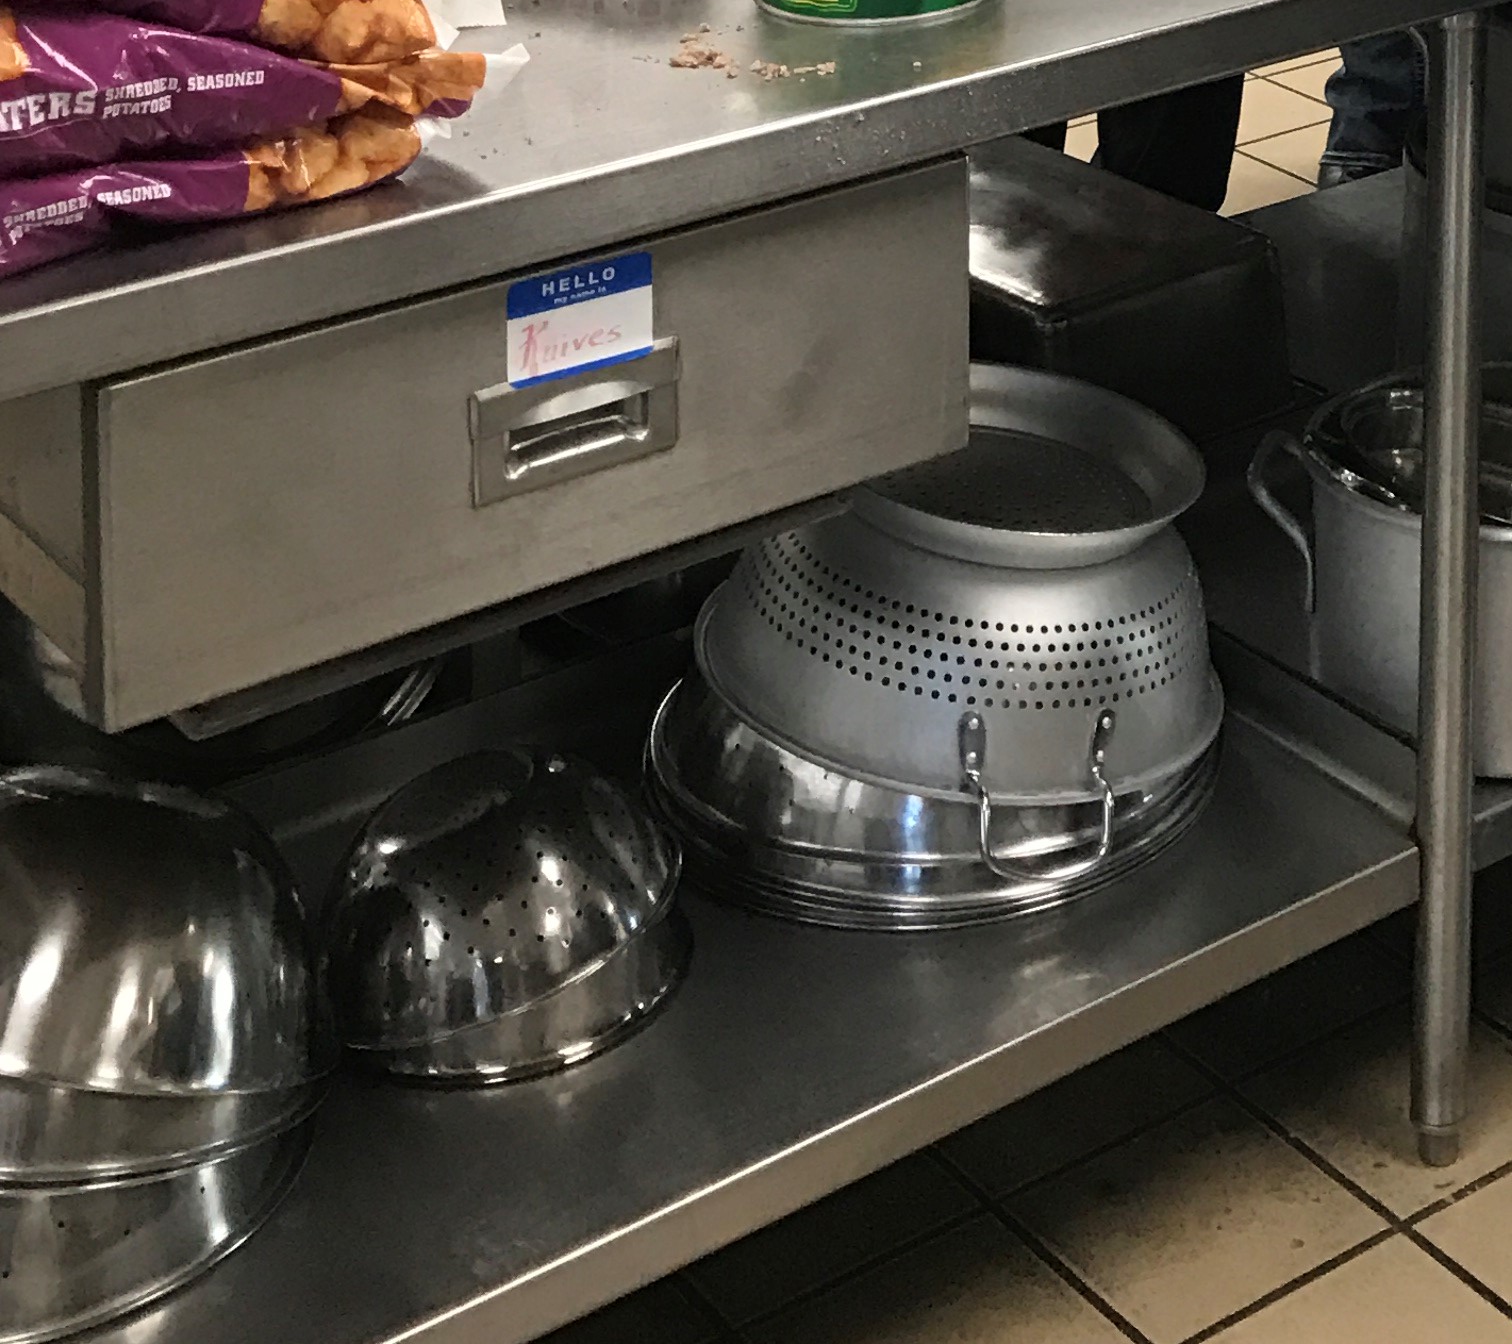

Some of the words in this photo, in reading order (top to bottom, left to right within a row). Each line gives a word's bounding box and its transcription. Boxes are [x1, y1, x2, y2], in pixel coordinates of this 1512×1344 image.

[104, 76, 182, 103] SHREDDED,
[187, 69, 266, 92] SEASONED
[102, 93, 173, 120] POTATOES
[3, 194, 93, 230] SHREDDED,
[96, 182, 173, 207] SEASONED
[541, 266, 617, 297] HELLO
[553, 295, 569, 305] my
[569, 288, 596, 300] name
[518, 319, 623, 374] Knives
